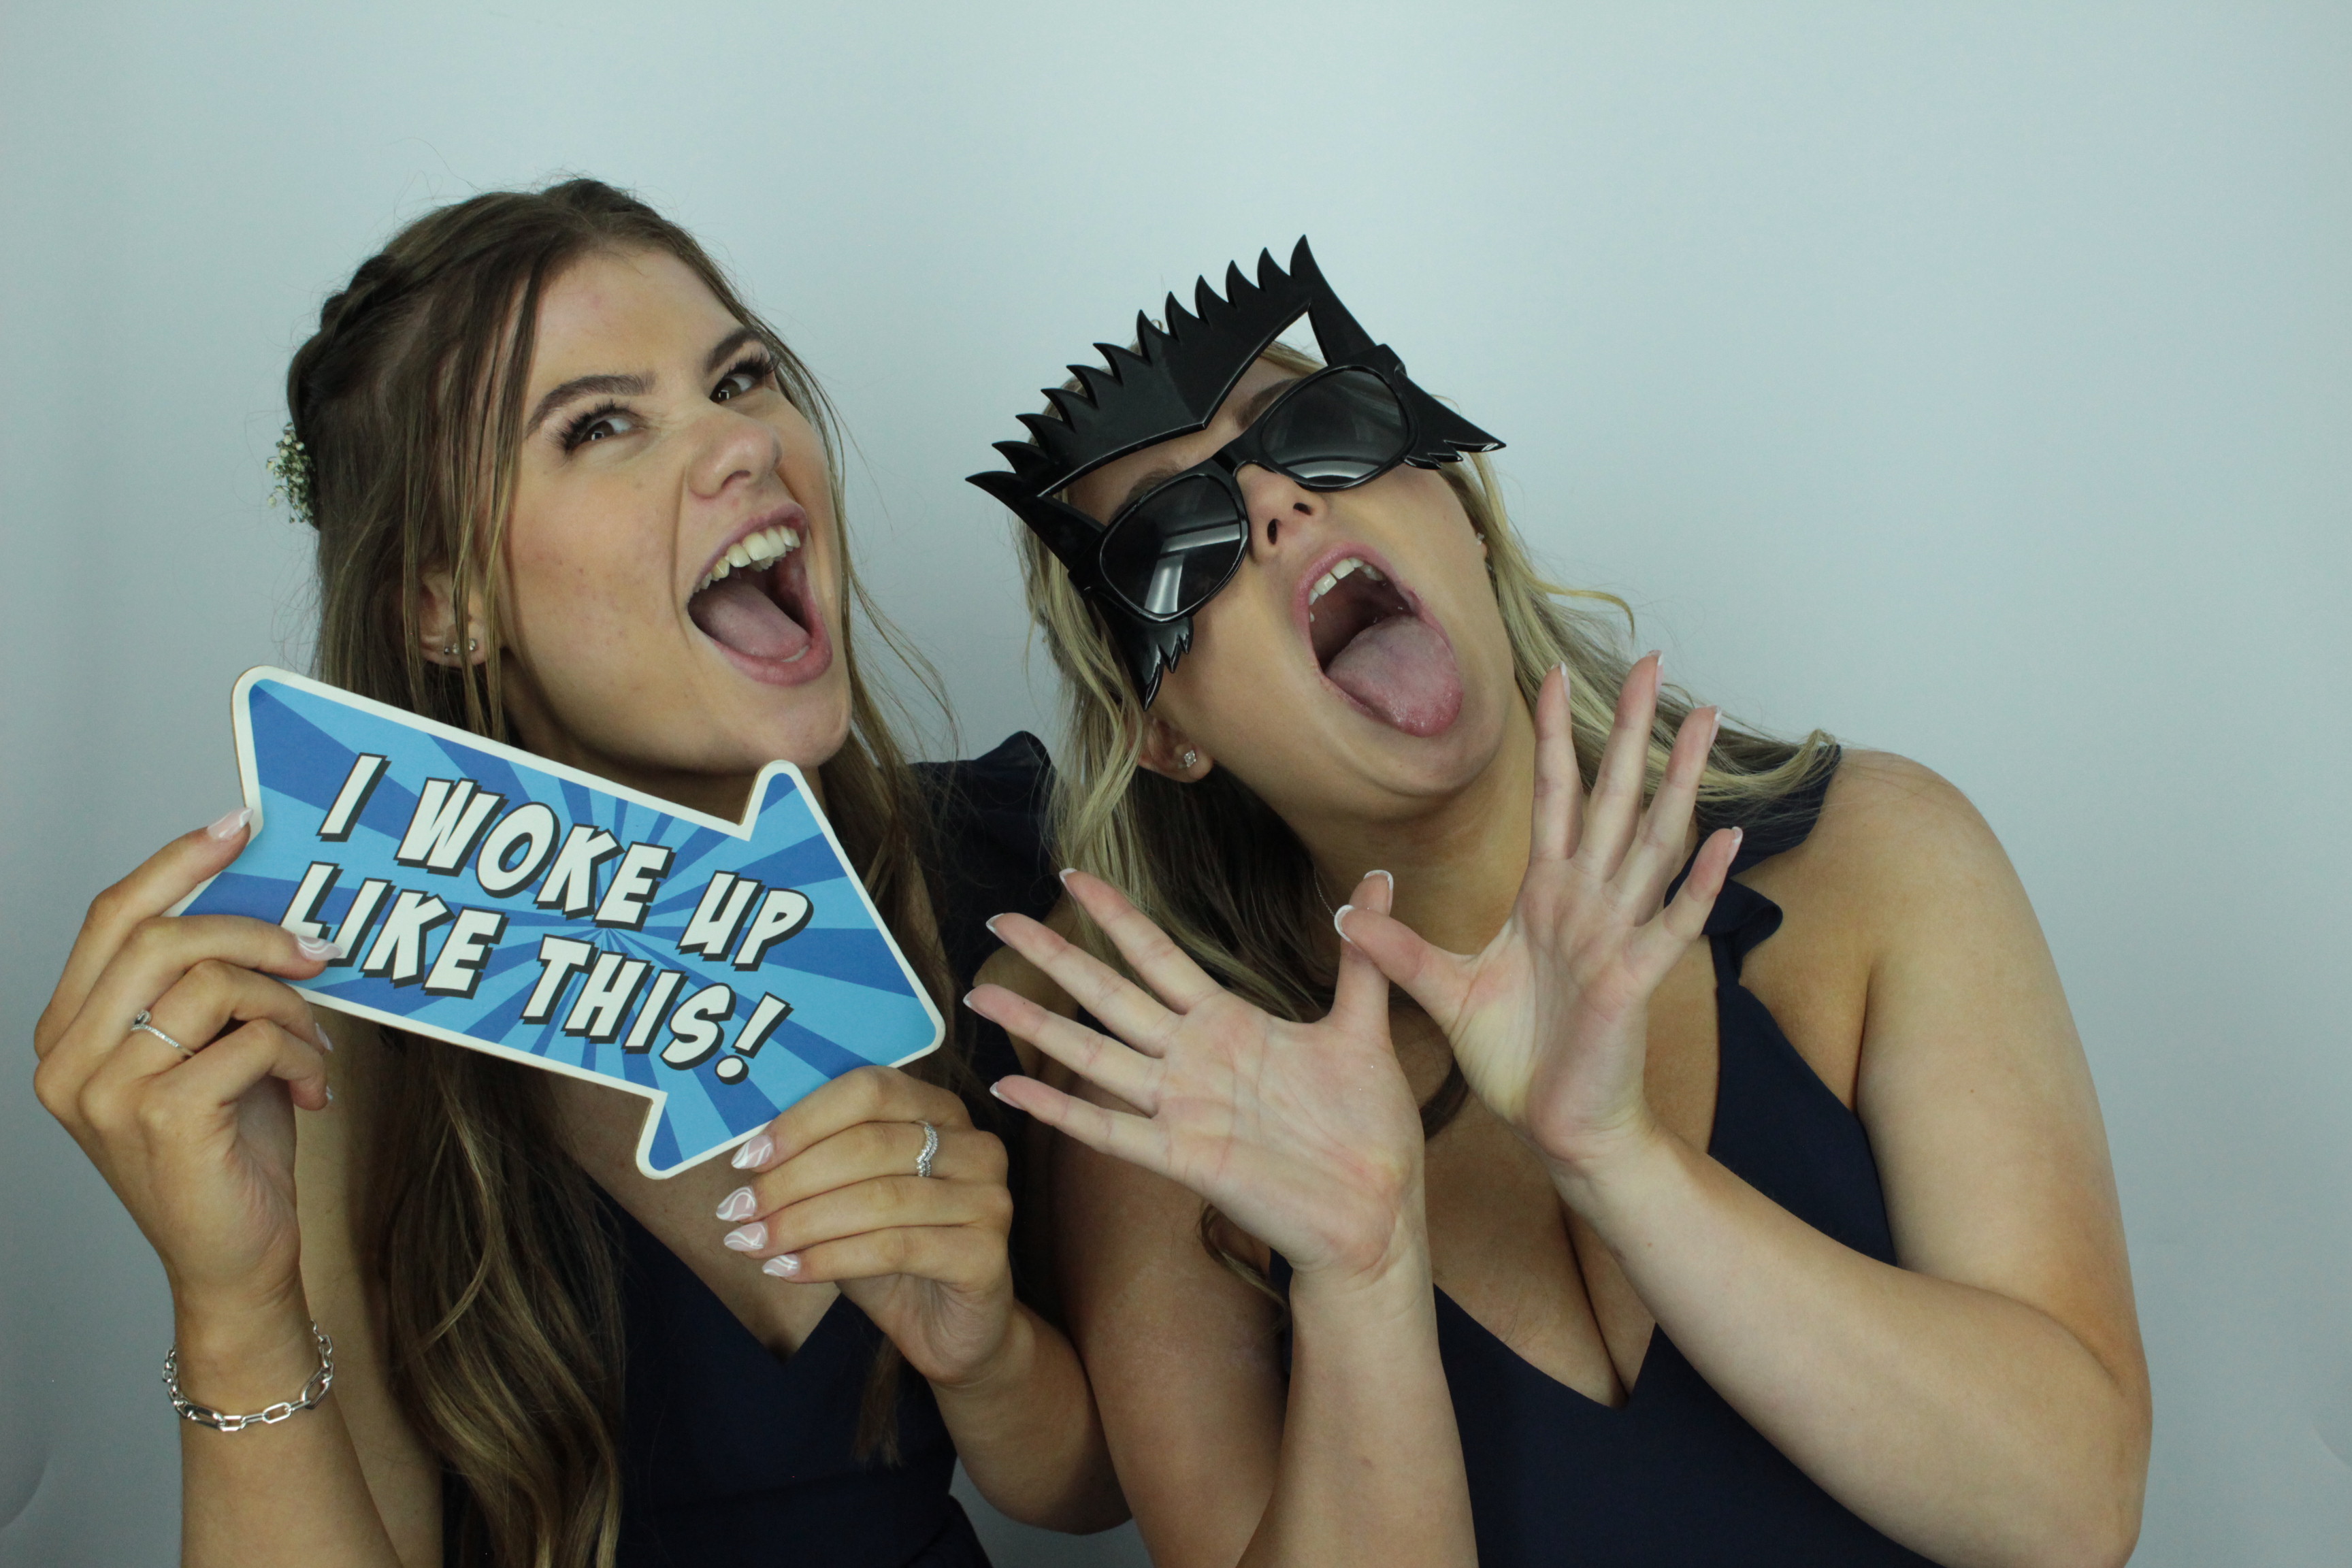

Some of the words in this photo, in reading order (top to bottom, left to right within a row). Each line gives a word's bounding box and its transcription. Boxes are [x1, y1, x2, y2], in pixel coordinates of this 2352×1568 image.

[317, 752, 391, 842] I
[395, 777, 674, 931] WOKE
[678, 870, 813, 971] UP
[280, 861, 509, 998] LIKE
[521, 934, 793, 1084] THIS!
